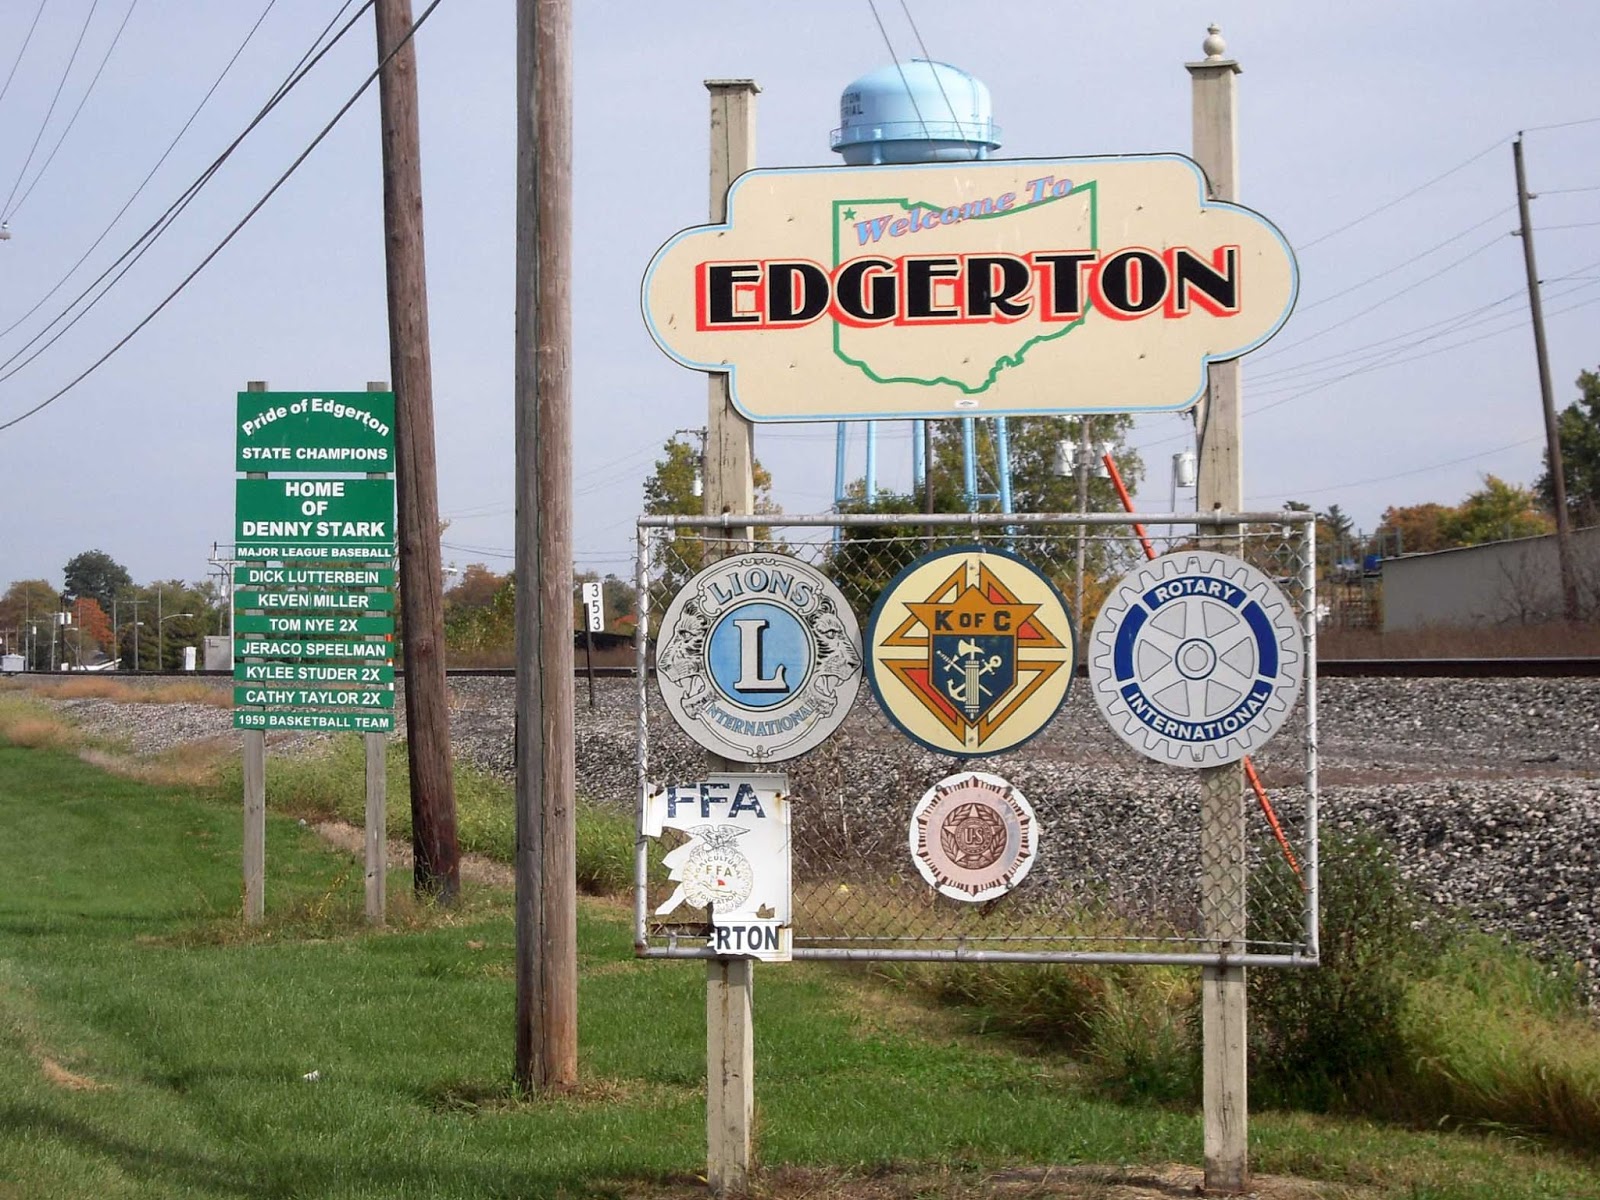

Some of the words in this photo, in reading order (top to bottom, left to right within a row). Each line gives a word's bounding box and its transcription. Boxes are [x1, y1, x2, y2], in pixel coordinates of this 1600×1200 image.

[853, 191, 1016, 246] Welcome
[1025, 175, 1074, 204] To
[697, 246, 1241, 331] EDGERTON
[241, 406, 287, 436] Pride
[290, 399, 308, 414] of
[311, 398, 390, 437] Edgerton
[242, 447, 291, 460] STATE
[295, 448, 388, 460] CHAMPIONS
[285, 481, 345, 497] HOME
[301, 501, 328, 516] OF
[242, 521, 313, 536] DENNY
[316, 522, 385, 537] STARK
[237, 547, 278, 557] MAJOR
[281, 548, 328, 557] LEAGUE
[331, 548, 392, 558] BASEBALL
[249, 570, 284, 582] DICK
[288, 571, 379, 584] LUTTERBEIN
[707, 568, 813, 608] LIONS
[1153, 578, 1237, 603] ROTARY
[258, 594, 309, 607] KEVEN
[313, 595, 369, 608] MILLER
[269, 619, 301, 631] TOM
[305, 619, 335, 632] NYE
[339, 619, 358, 632] 2X
[934, 610, 954, 631] K
[959, 613, 986, 628] OF
[993, 610, 1011, 631] C
[241, 642, 302, 655] JERACO
[305, 643, 386, 657] SPEELMAN
[733, 619, 790, 693] L
[246, 666, 294, 679] KYLEE
[297, 667, 357, 680] STUDER
[361, 668, 380, 681] 2X
[245, 690, 296, 703] CATHY
[299, 691, 358, 704] TAYLOR
[361, 692, 381, 705] 2X
[238, 715, 266, 725] 1959
[269, 716, 350, 727] BASKETBALL
[355, 717, 389, 728] TEAM
[701, 699, 819, 736] INTERNATIONAL
[1127, 690, 1269, 740] INTERNATIONAL
[665, 783, 766, 818] FFA
[706, 865, 732, 877] FFA
